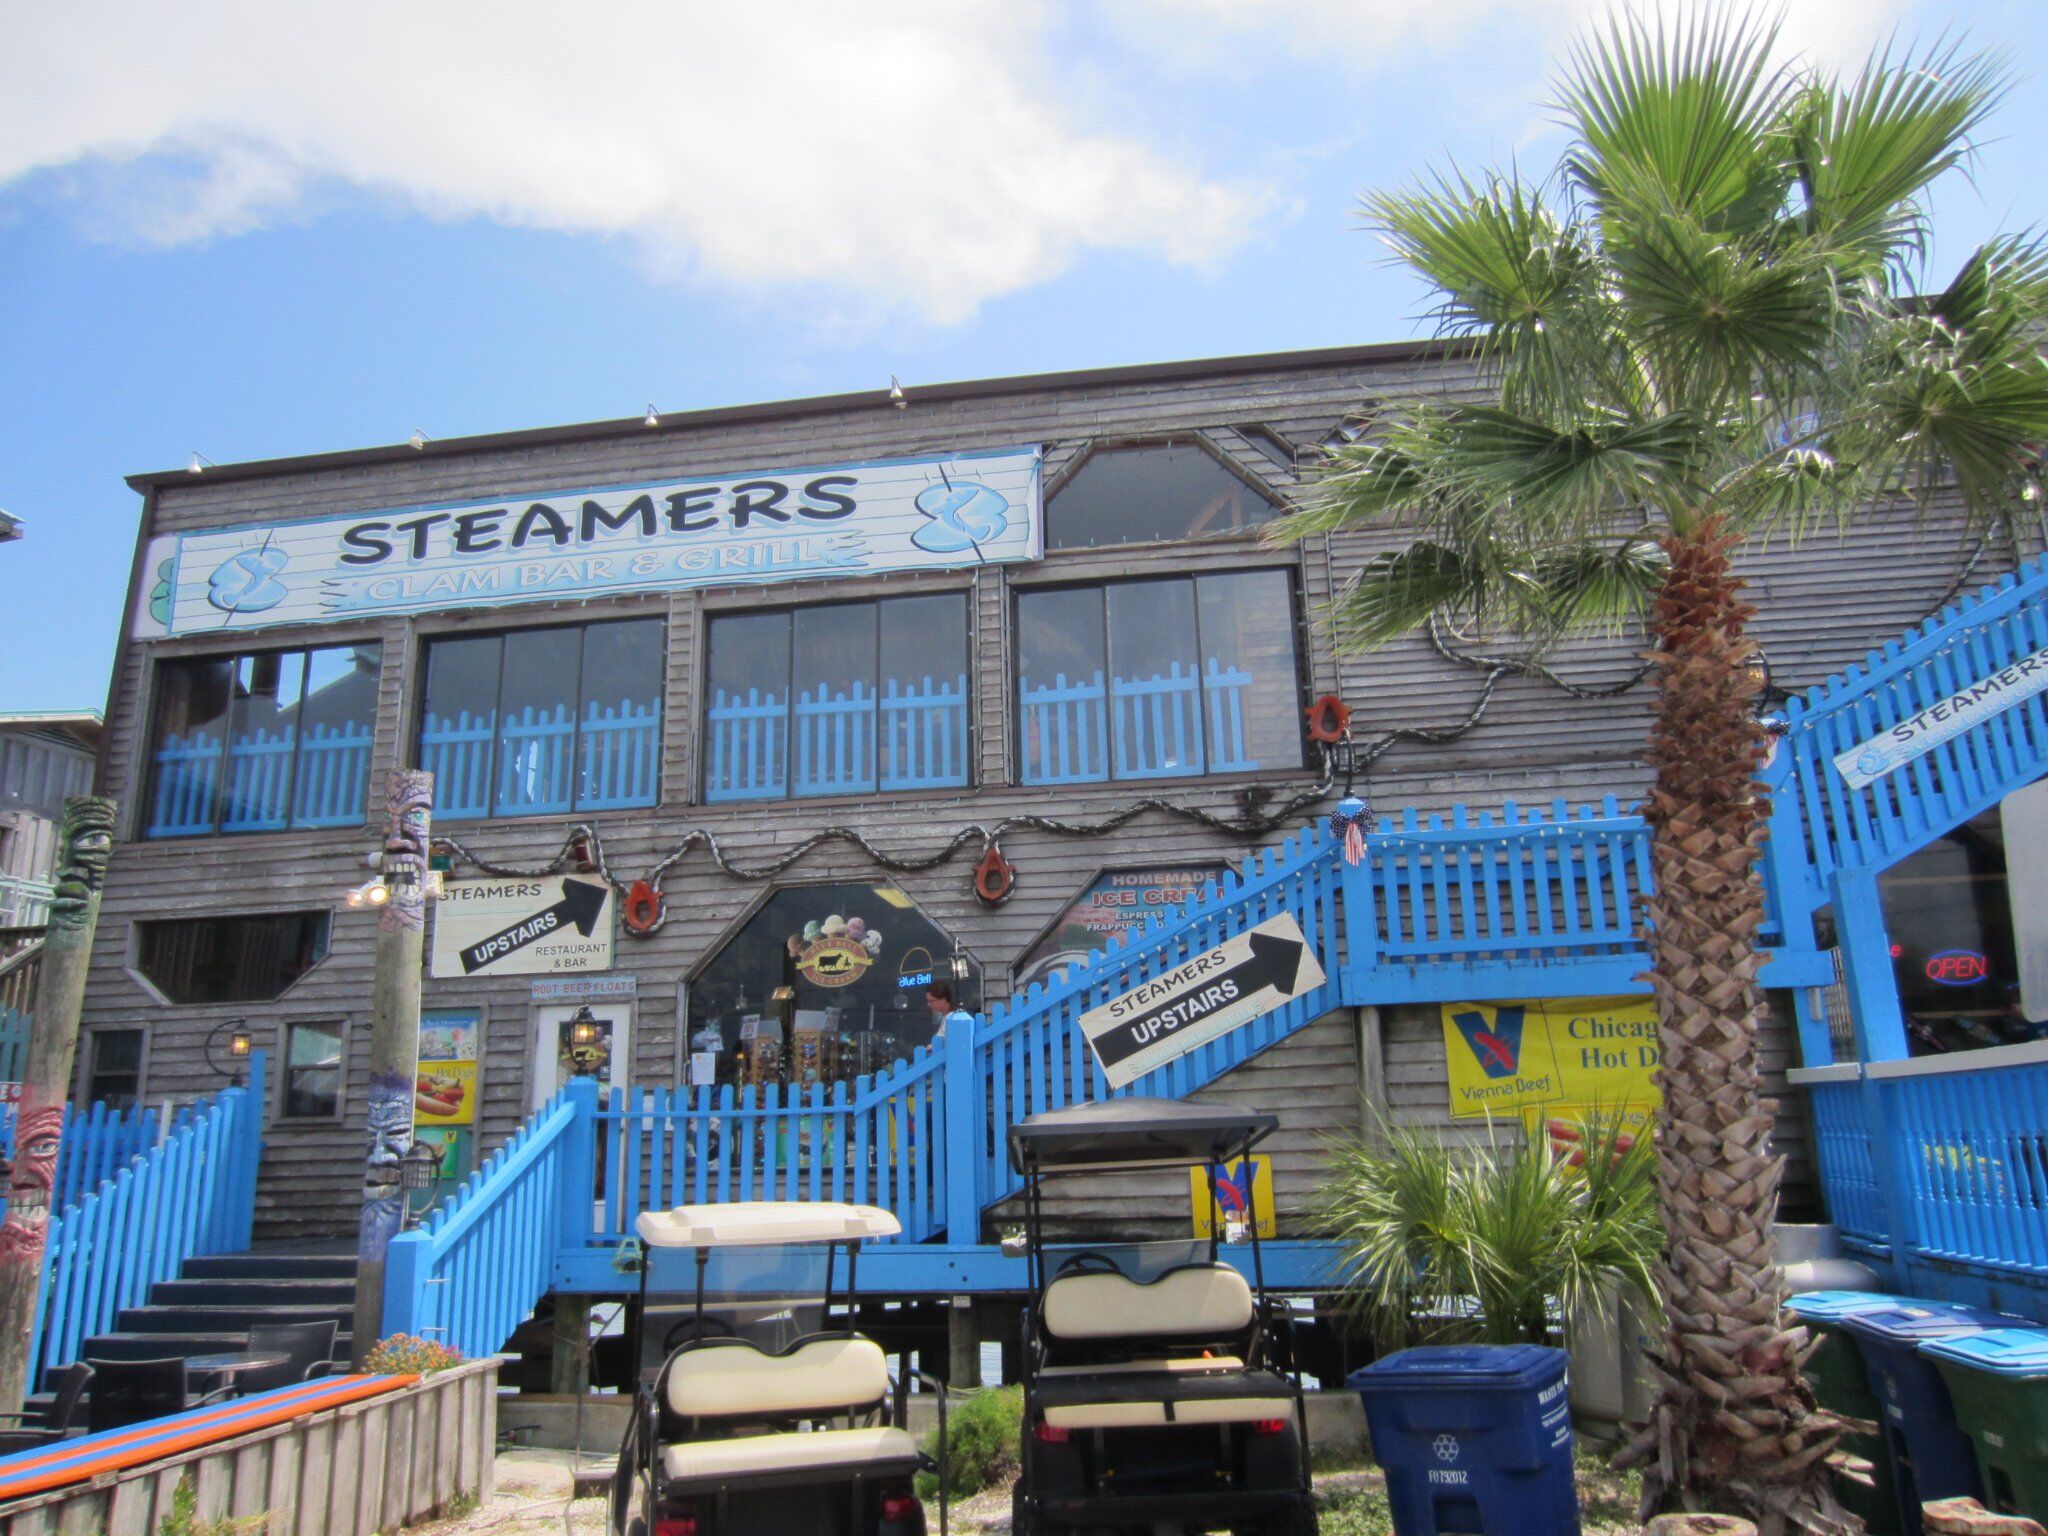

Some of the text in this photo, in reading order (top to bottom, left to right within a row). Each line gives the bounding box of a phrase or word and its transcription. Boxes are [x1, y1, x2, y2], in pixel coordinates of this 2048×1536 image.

[340, 476, 859, 566] STEAMERS
[367, 537, 823, 601] CLAM BAR & GRILL
[1892, 647, 2048, 743] STEAMERS
[1112, 871, 1217, 887] HOMEMADE
[438, 883, 542, 902] STEAMERS
[1092, 889, 1137, 907] ICE
[1115, 909, 1165, 920] ESPRESS
[474, 912, 558, 963] UPSTAIRS
[535, 943, 607, 957] RESTAURANT
[554, 957, 587, 968] & BAR
[1925, 956, 1988, 980] OPEN
[533, 980, 634, 994] ROOT BEER FLOATS
[898, 972, 932, 989] Blue Bell
[1109, 950, 1227, 1018] STEAMERS
[1131, 979, 1239, 1046] UPSTAIRS
[1568, 1016, 1659, 1042] Chicag
[1581, 1046, 1628, 1068] Hot
[1460, 1074, 1551, 1101] Vienna Beef
